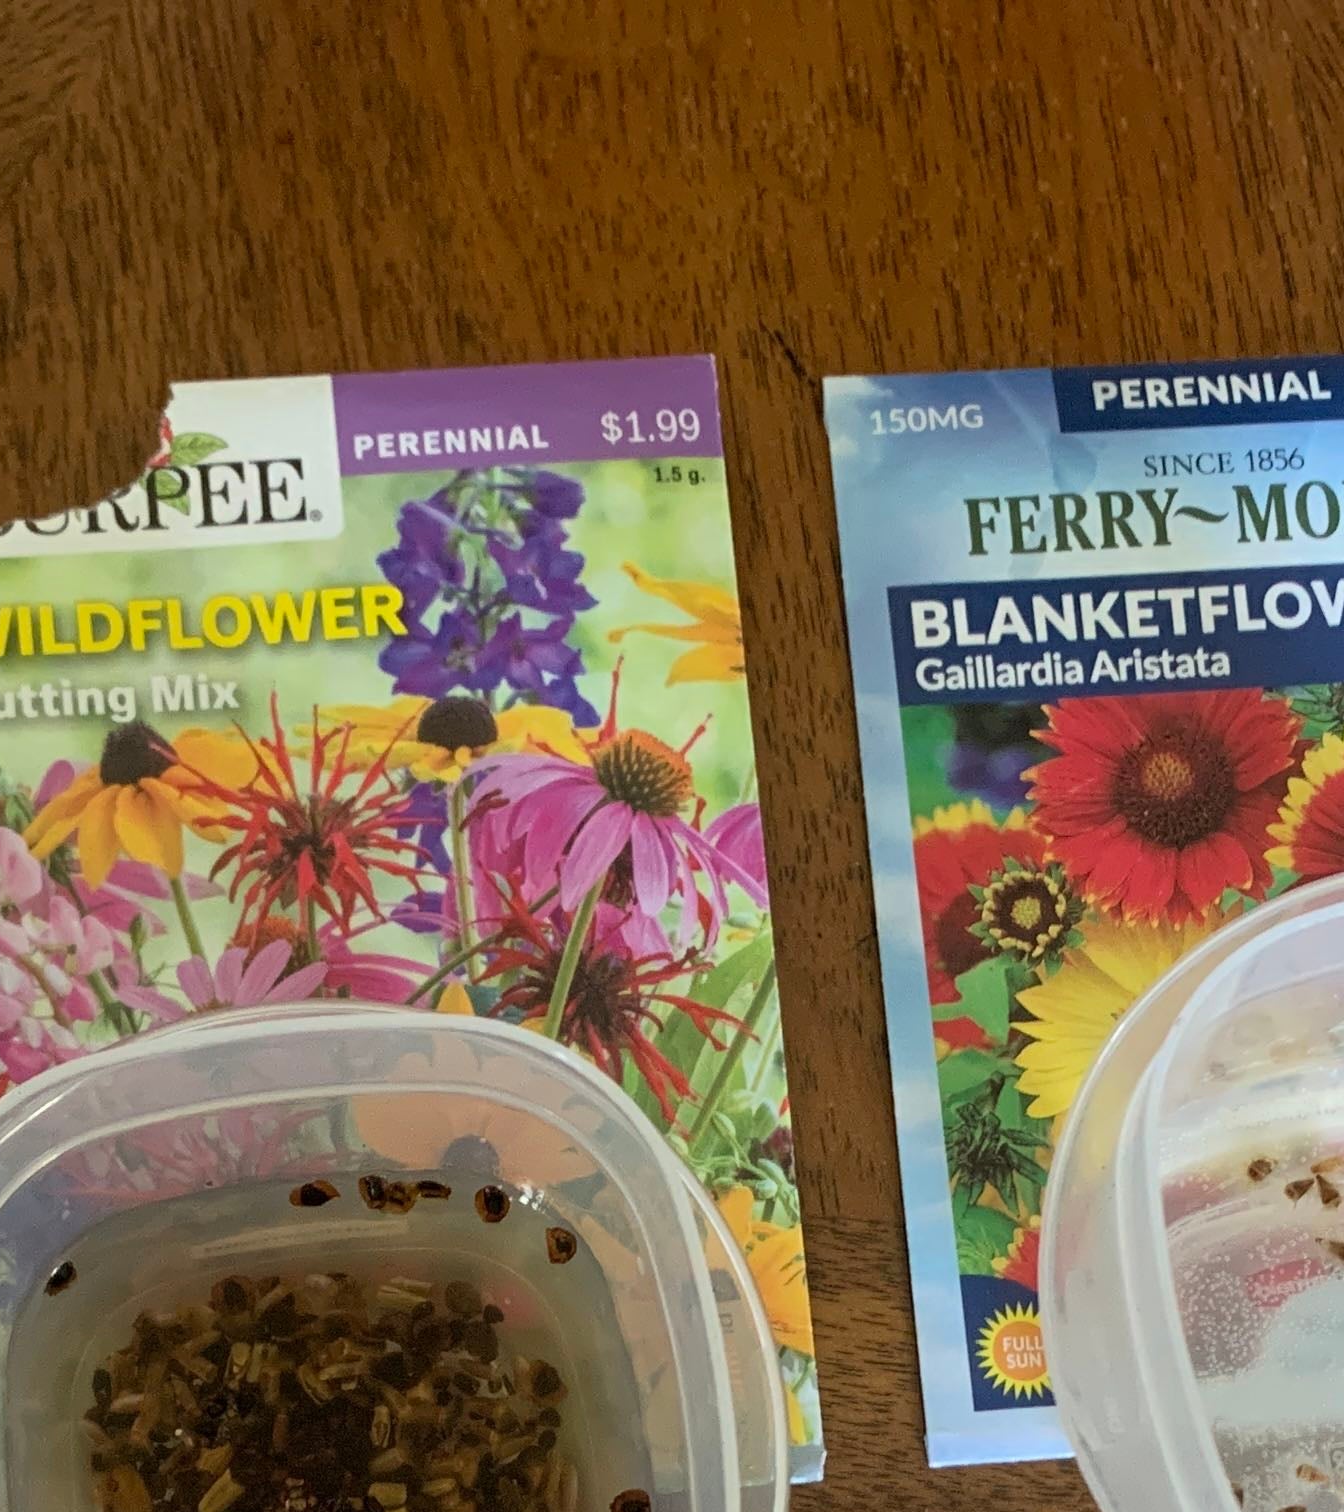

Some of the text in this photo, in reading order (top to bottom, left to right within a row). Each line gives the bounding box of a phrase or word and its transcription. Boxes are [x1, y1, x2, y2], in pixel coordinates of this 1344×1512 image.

[1092, 369, 1332, 412] PERENNIAL
[600, 408, 702, 446] $1.99
[868, 404, 984, 436] 150MG
[353, 424, 550, 461] PERENNIAL
[654, 466, 679, 486] 1.5
[1143, 447, 1305, 479] SINCE 1856
[915, 645, 1230, 693] Gaillardia Aristata
[152, 673, 240, 716] Mix
[1002, 1336, 1044, 1353] FULL
[1006, 1353, 1042, 1369] SUN
